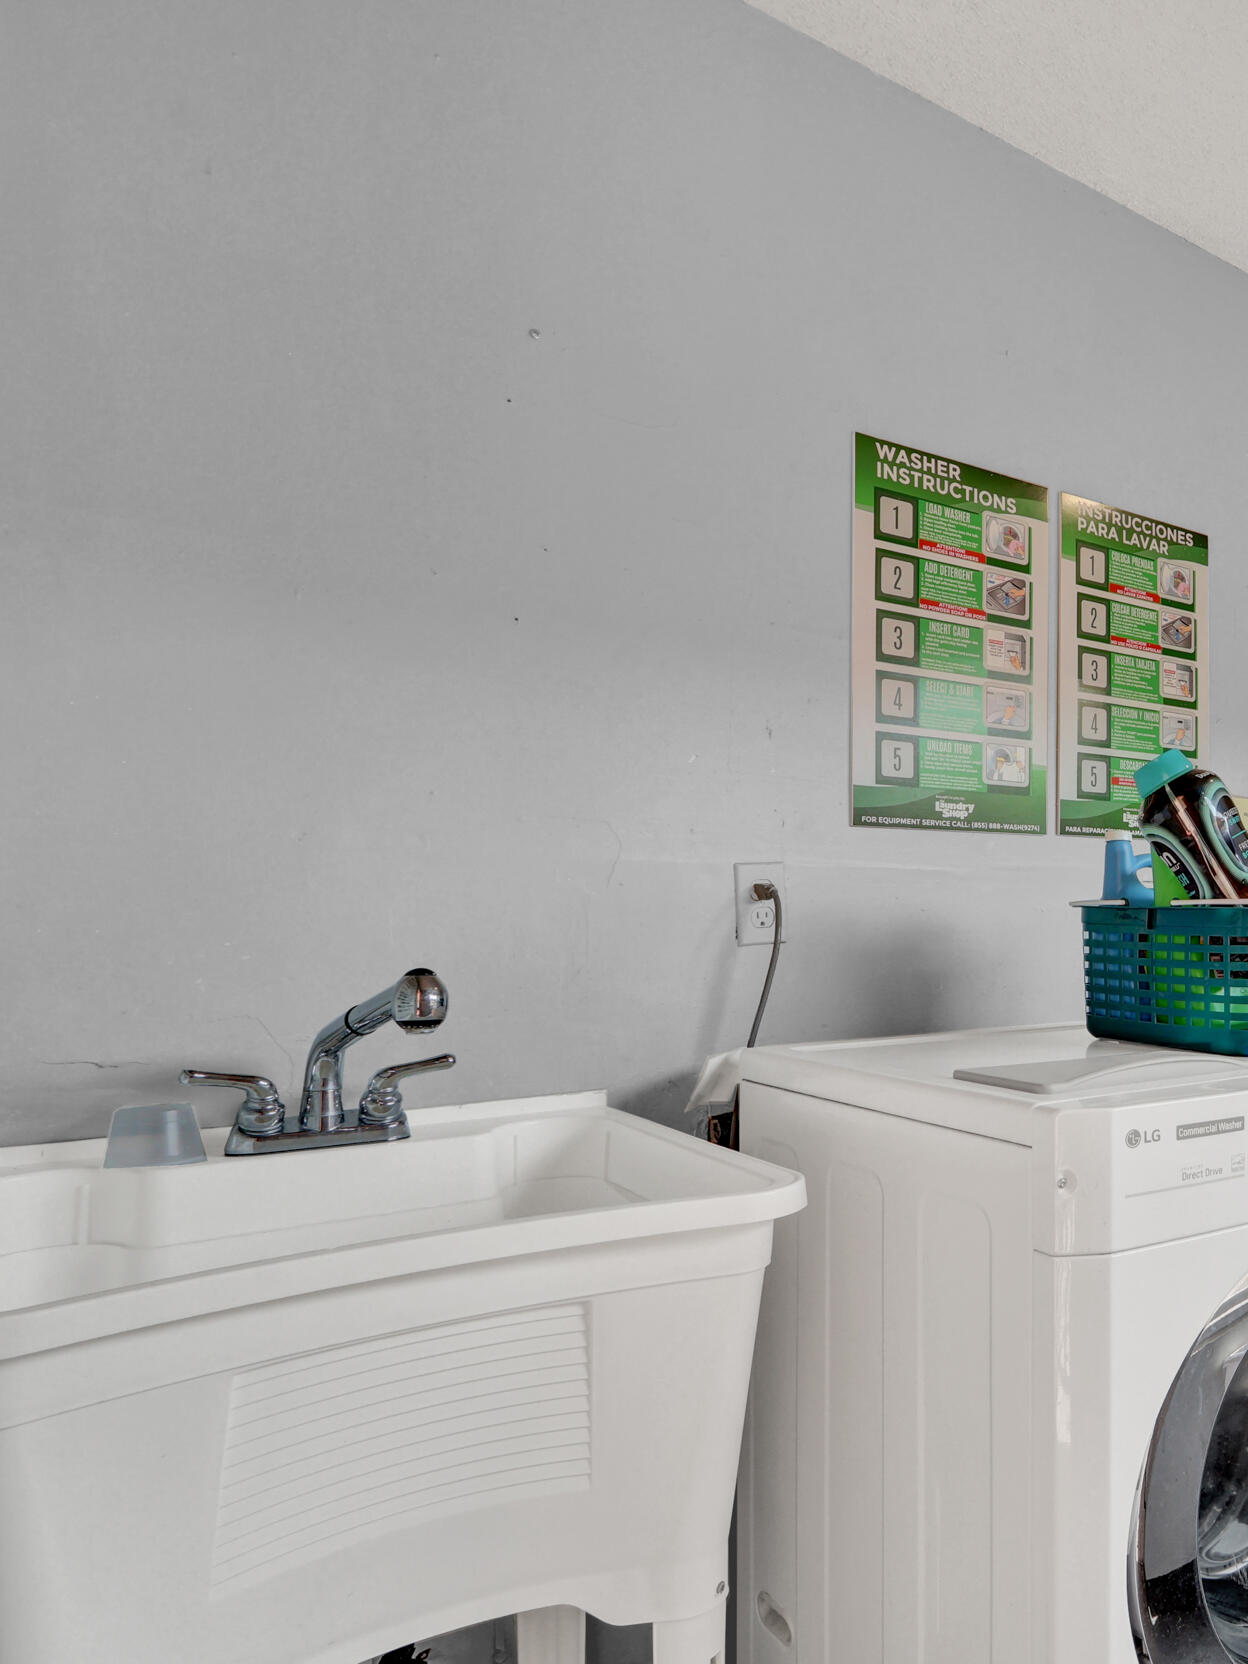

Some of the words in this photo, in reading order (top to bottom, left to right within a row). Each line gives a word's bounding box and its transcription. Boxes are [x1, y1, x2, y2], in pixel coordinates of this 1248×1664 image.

[875, 442, 961, 481] WASHER
[876, 462, 1017, 513] INSTRUCTIONS
[892, 506, 899, 529] 1
[925, 502, 942, 516] LOAD
[944, 506, 970, 523] WASHER
[1077, 501, 1194, 547] INSTRUCCIONES
[1077, 517, 1119, 542] PARA
[1123, 529, 1169, 556] LAVAR
[956, 553, 979, 562] WASHERS
[1089, 555, 1095, 577] 1
[894, 566, 901, 590] 2
[925, 561, 938, 574] ADD
[940, 564, 973, 581] DETERGENT
[1090, 607, 1097, 629] 2
[894, 626, 902, 650] 3
[929, 621, 951, 635] INSERT
[953, 625, 970, 638] CARD
[1091, 660, 1098, 681] 3
[893, 687, 903, 711] 4
[1090, 713, 1098, 734] 4
[927, 740, 952, 752] UNLOAD
[954, 743, 973, 755] ITEMS
[894, 747, 902, 771] 5
[1091, 766, 1097, 787] 5
[935, 800, 975, 813] Laundry
[879, 816, 920, 825] EQUIPMENT
[921, 818, 950, 827] SERVICE
[952, 820, 971, 829] CALL:
[1144, 1129, 1161, 1143] LG
[1178, 1123, 1218, 1137] Commercial
[1219, 1120, 1243, 1131] Washer
[1181, 1169, 1204, 1181] Direct
[1205, 1167, 1223, 1177] Drive
